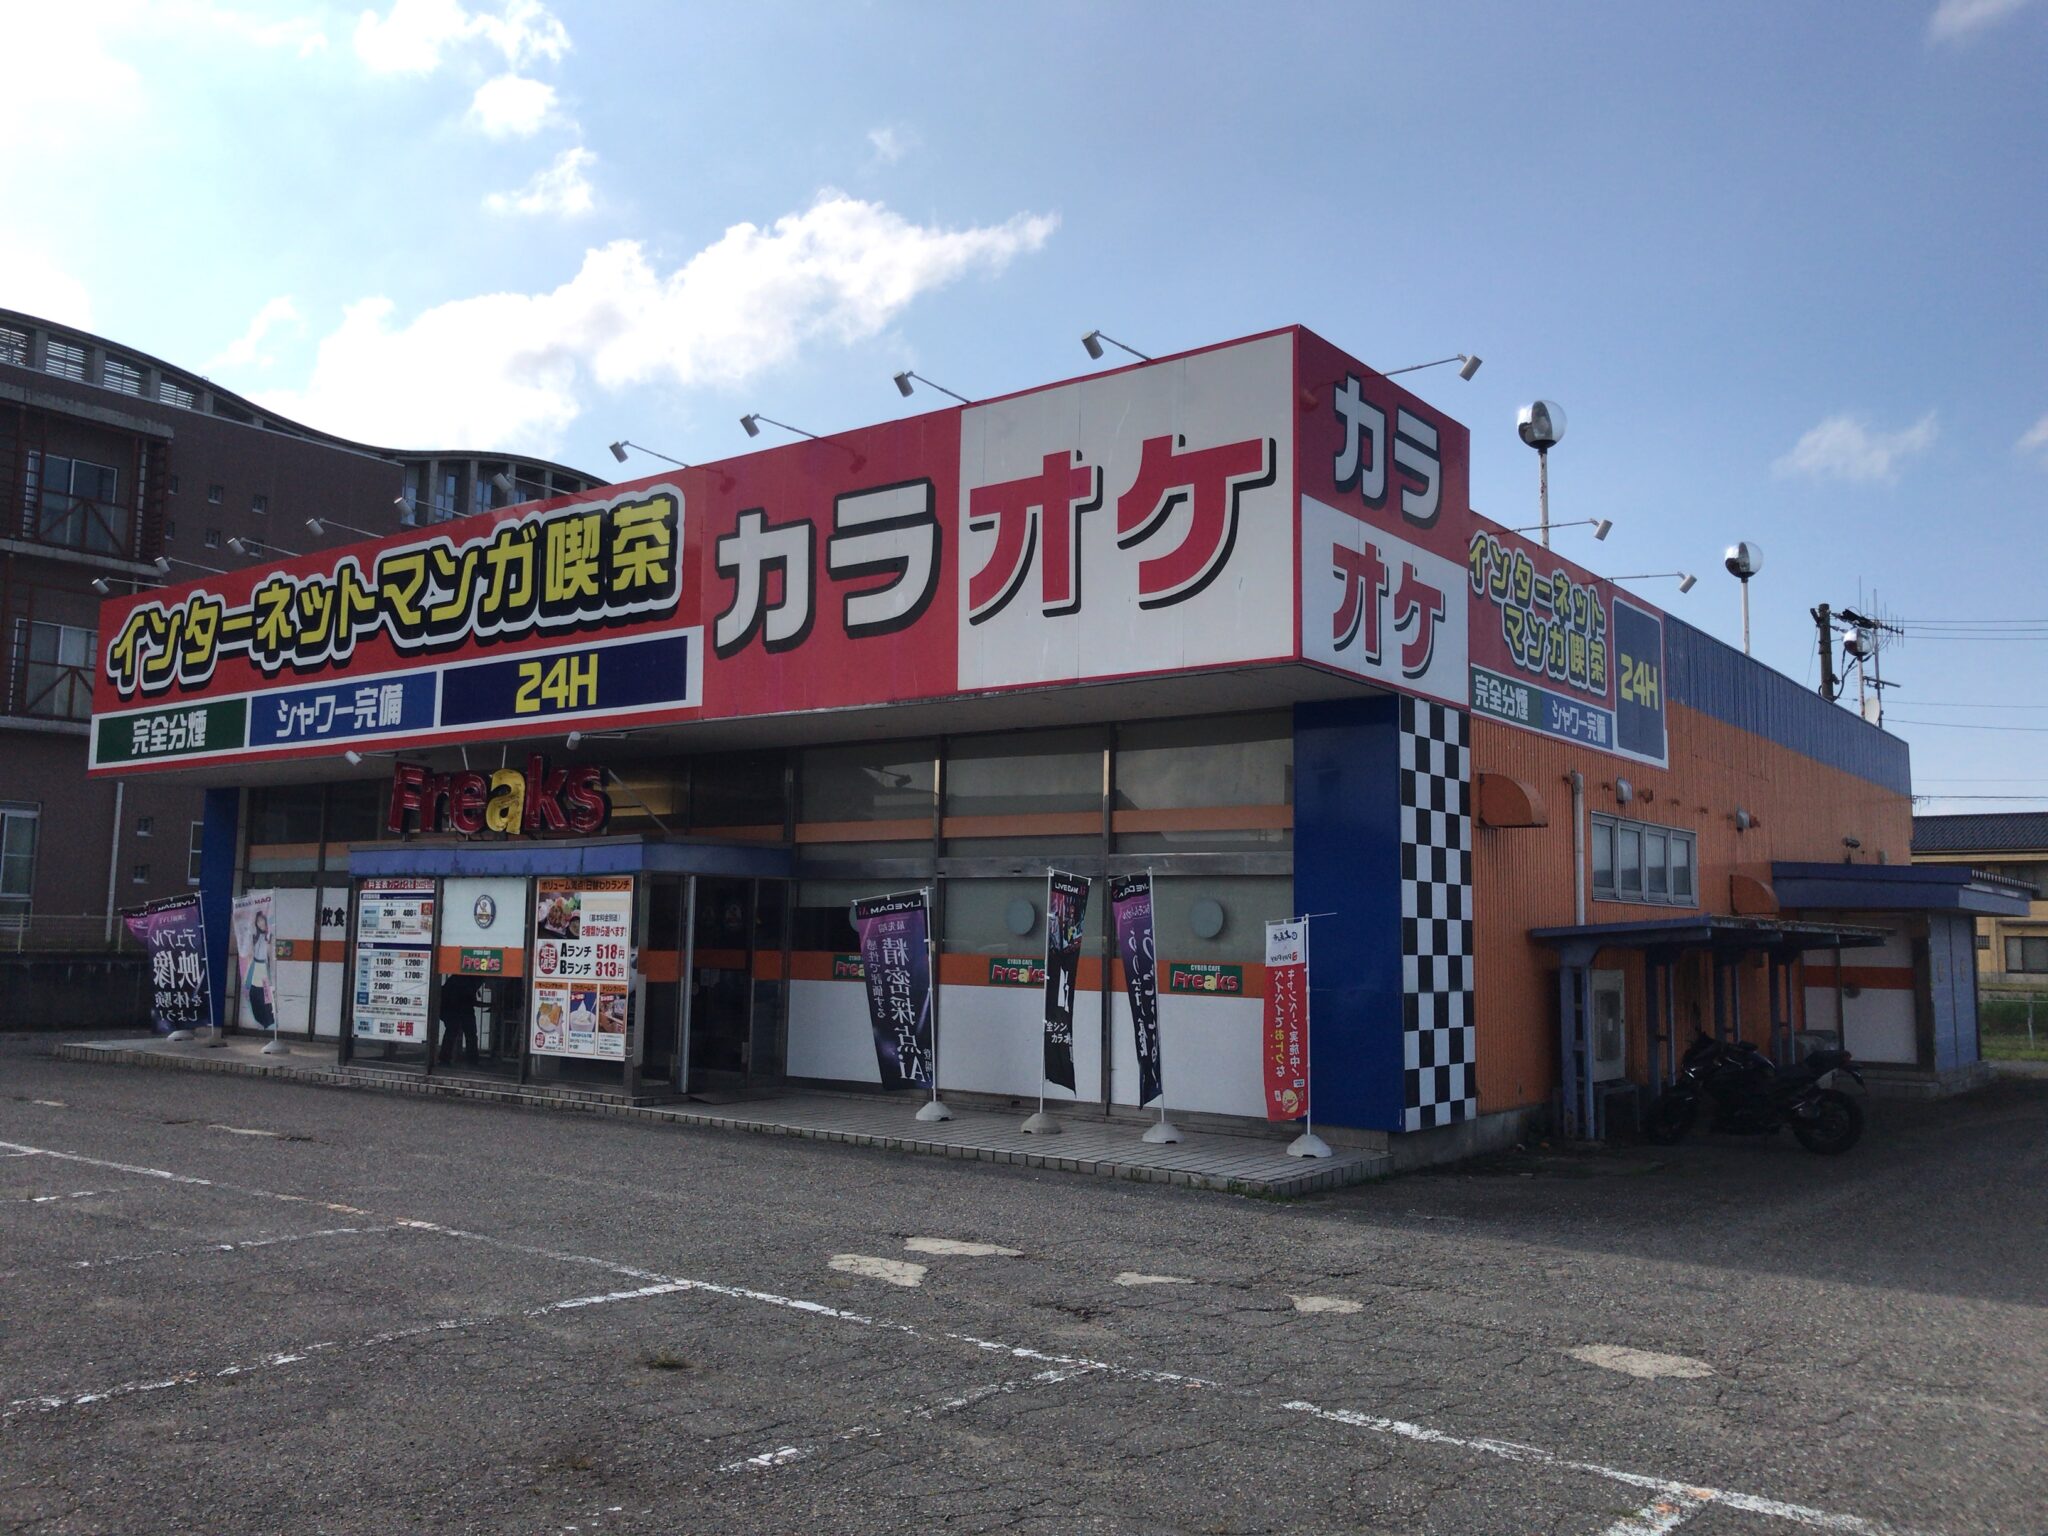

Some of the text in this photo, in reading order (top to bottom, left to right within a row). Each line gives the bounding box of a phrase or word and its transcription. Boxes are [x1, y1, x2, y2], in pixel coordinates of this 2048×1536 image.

[1334, 373, 1441, 528] カラ
[1333, 540, 1445, 678] オケ
[1470, 532, 1606, 637] インターネット
[1502, 604, 1607, 694] マンガ喫茶
[516, 652, 598, 714] 24H
[1475, 674, 1529, 721] 完全分煙
[1620, 653, 1659, 710] 24H
[132, 712, 207, 755] 完全分煙
[275, 683, 403, 738] シャワー完備
[1552, 700, 1606, 744] シャワー完備
[388, 752, 612, 835] Freaks
[560, 960, 591, 975] Bランチ
[561, 943, 591, 957] Aランチ
[1173, 970, 1239, 991] Freaks
